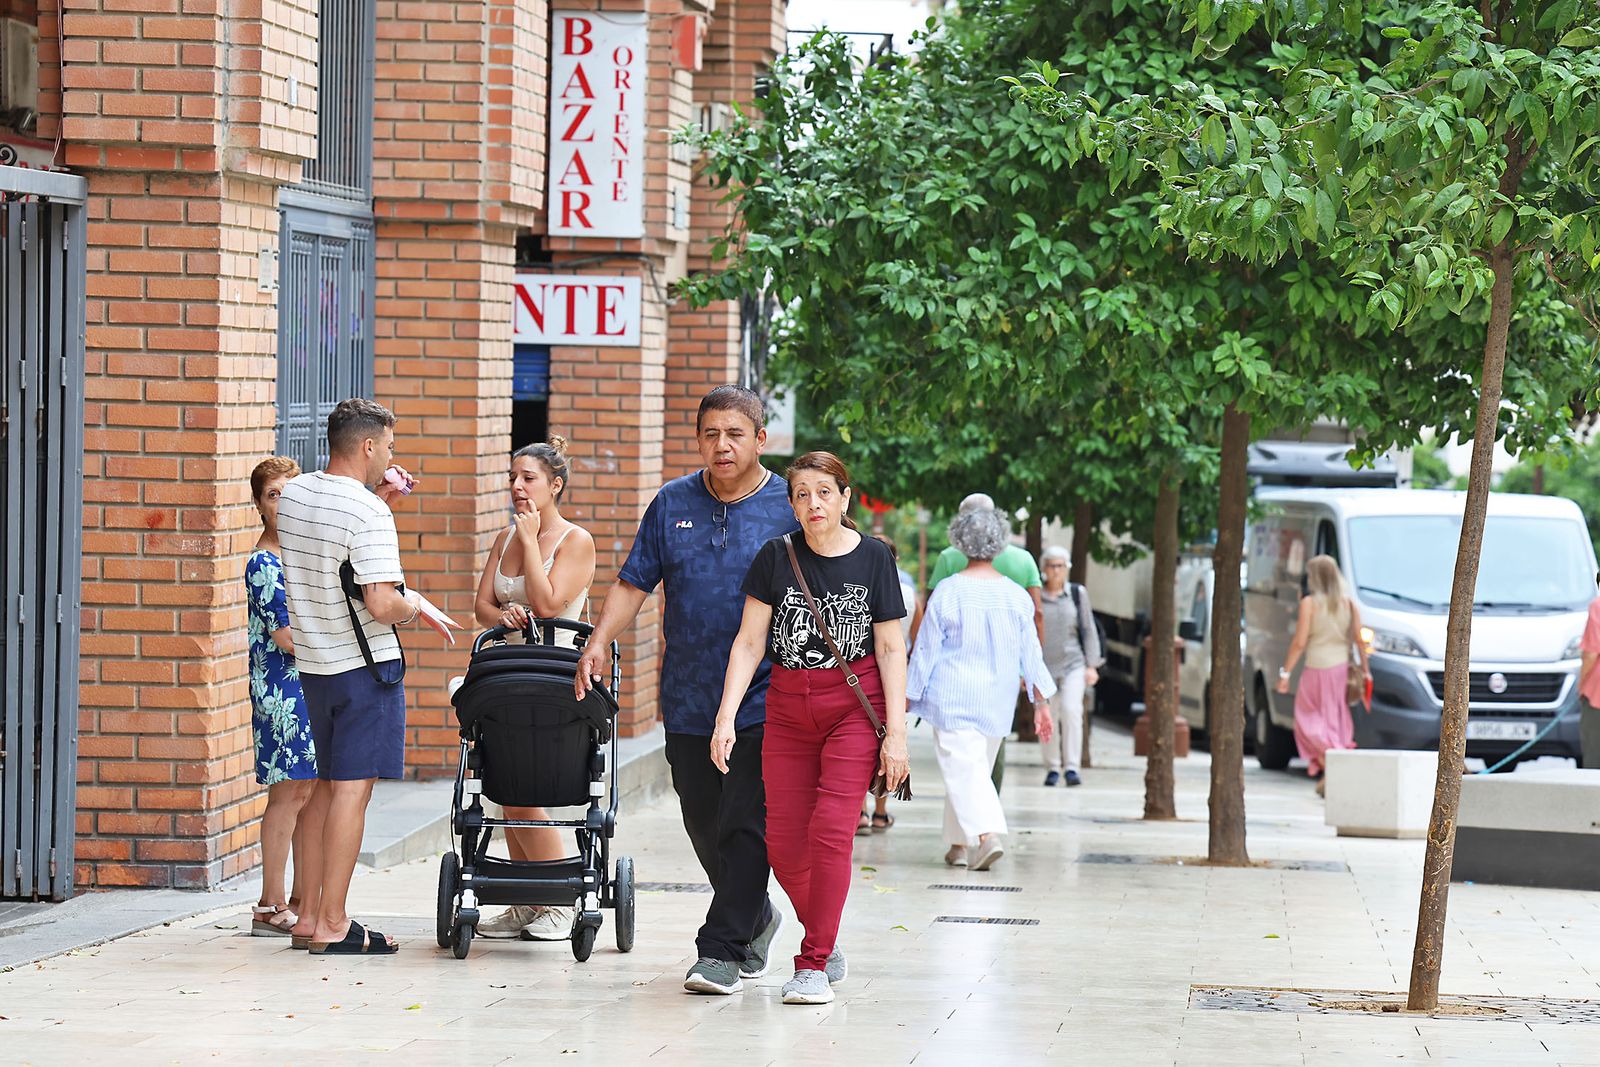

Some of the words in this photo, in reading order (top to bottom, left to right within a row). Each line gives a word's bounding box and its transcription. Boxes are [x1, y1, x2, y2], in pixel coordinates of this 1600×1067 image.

[558, 17, 596, 229] BAZAR
[611, 46, 633, 202] ORIENTE
[676, 520, 693, 528] FILA
